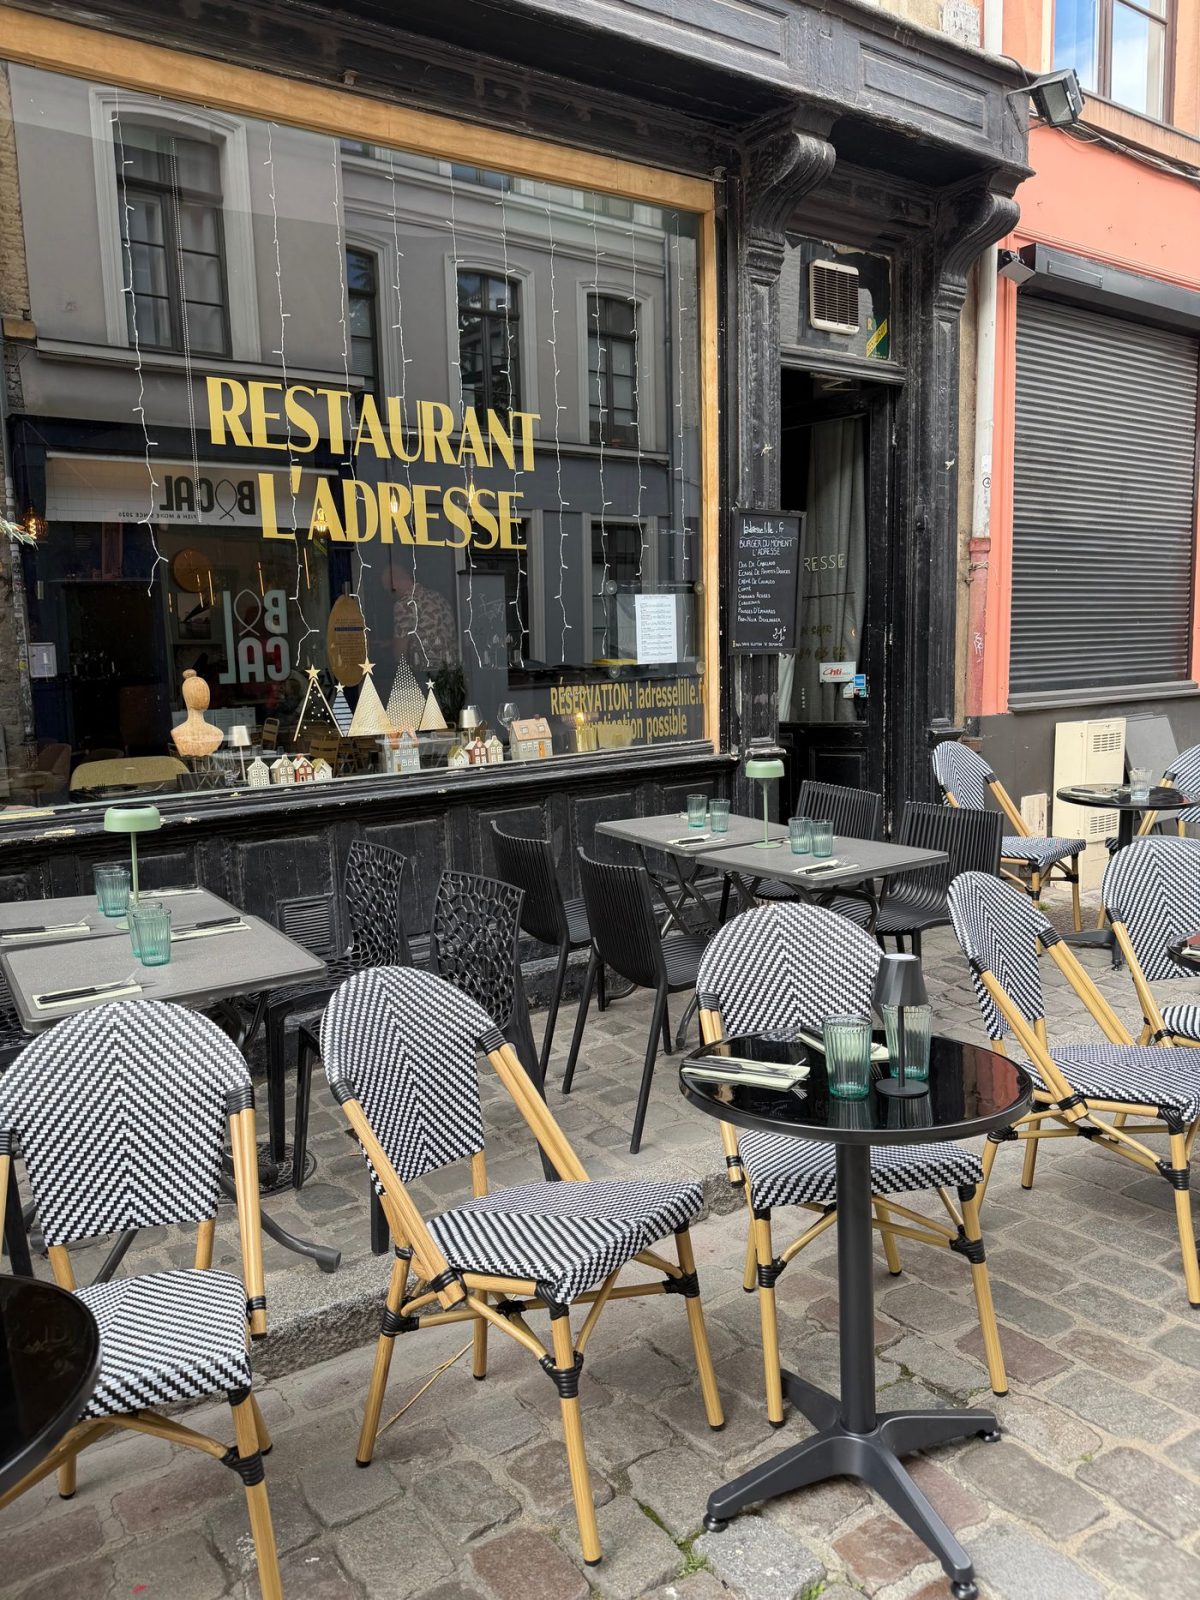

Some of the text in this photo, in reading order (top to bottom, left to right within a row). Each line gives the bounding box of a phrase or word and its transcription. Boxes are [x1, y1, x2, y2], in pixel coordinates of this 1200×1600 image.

[206, 376, 541, 472] RESTAURANT
[257, 465, 527, 550] L'ADRESSE
[739, 539, 792, 548] BURGER DU MOMENT
[752, 547, 780, 557] L'ADRESSE
[635, 677, 706, 709] ladresselille.f
[646, 708, 688, 744] possible
